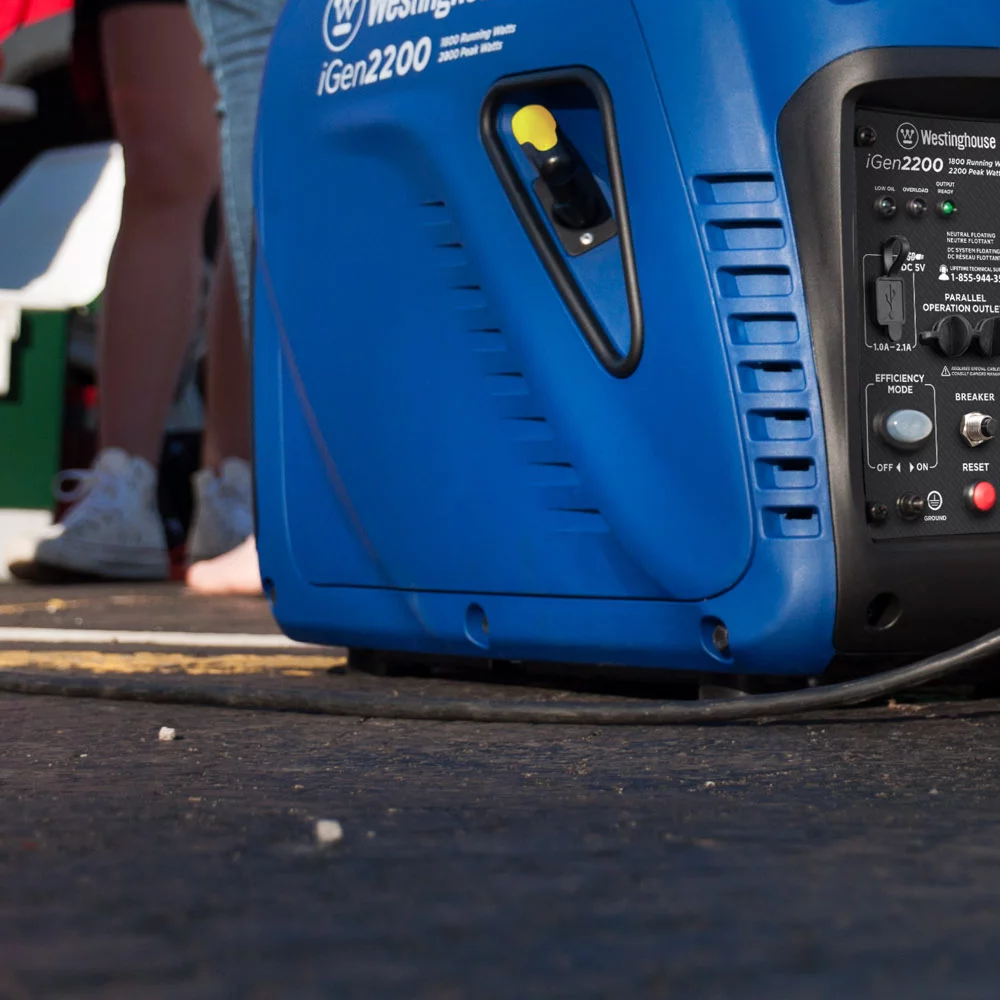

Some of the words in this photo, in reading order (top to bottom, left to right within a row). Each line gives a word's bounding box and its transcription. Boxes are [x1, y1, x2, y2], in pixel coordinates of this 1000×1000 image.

[460, 29, 492, 44] Running
[493, 23, 517, 37] Watts
[316, 36, 433, 97] iGen2200
[921, 129, 997, 151] Westinghouse
[865, 154, 944, 173] iGen2200
[948, 158, 965, 166] 1800
[966, 159, 993, 169] Running
[948, 167, 967, 175] 2200
[968, 168, 985, 176] Peak
[901, 263, 913, 272] DC
[914, 263, 926, 272] 5V
[944, 293, 987, 303] PARALLEL
[922, 303, 971, 313] OPERATION
[875, 373, 925, 383] EFFICIENCY
[887, 385, 914, 395] MODE
[955, 392, 996, 402] BREAKER
[876, 463, 894, 472] OFF
[916, 462, 929, 471] ON
[962, 462, 990, 472] RESET
